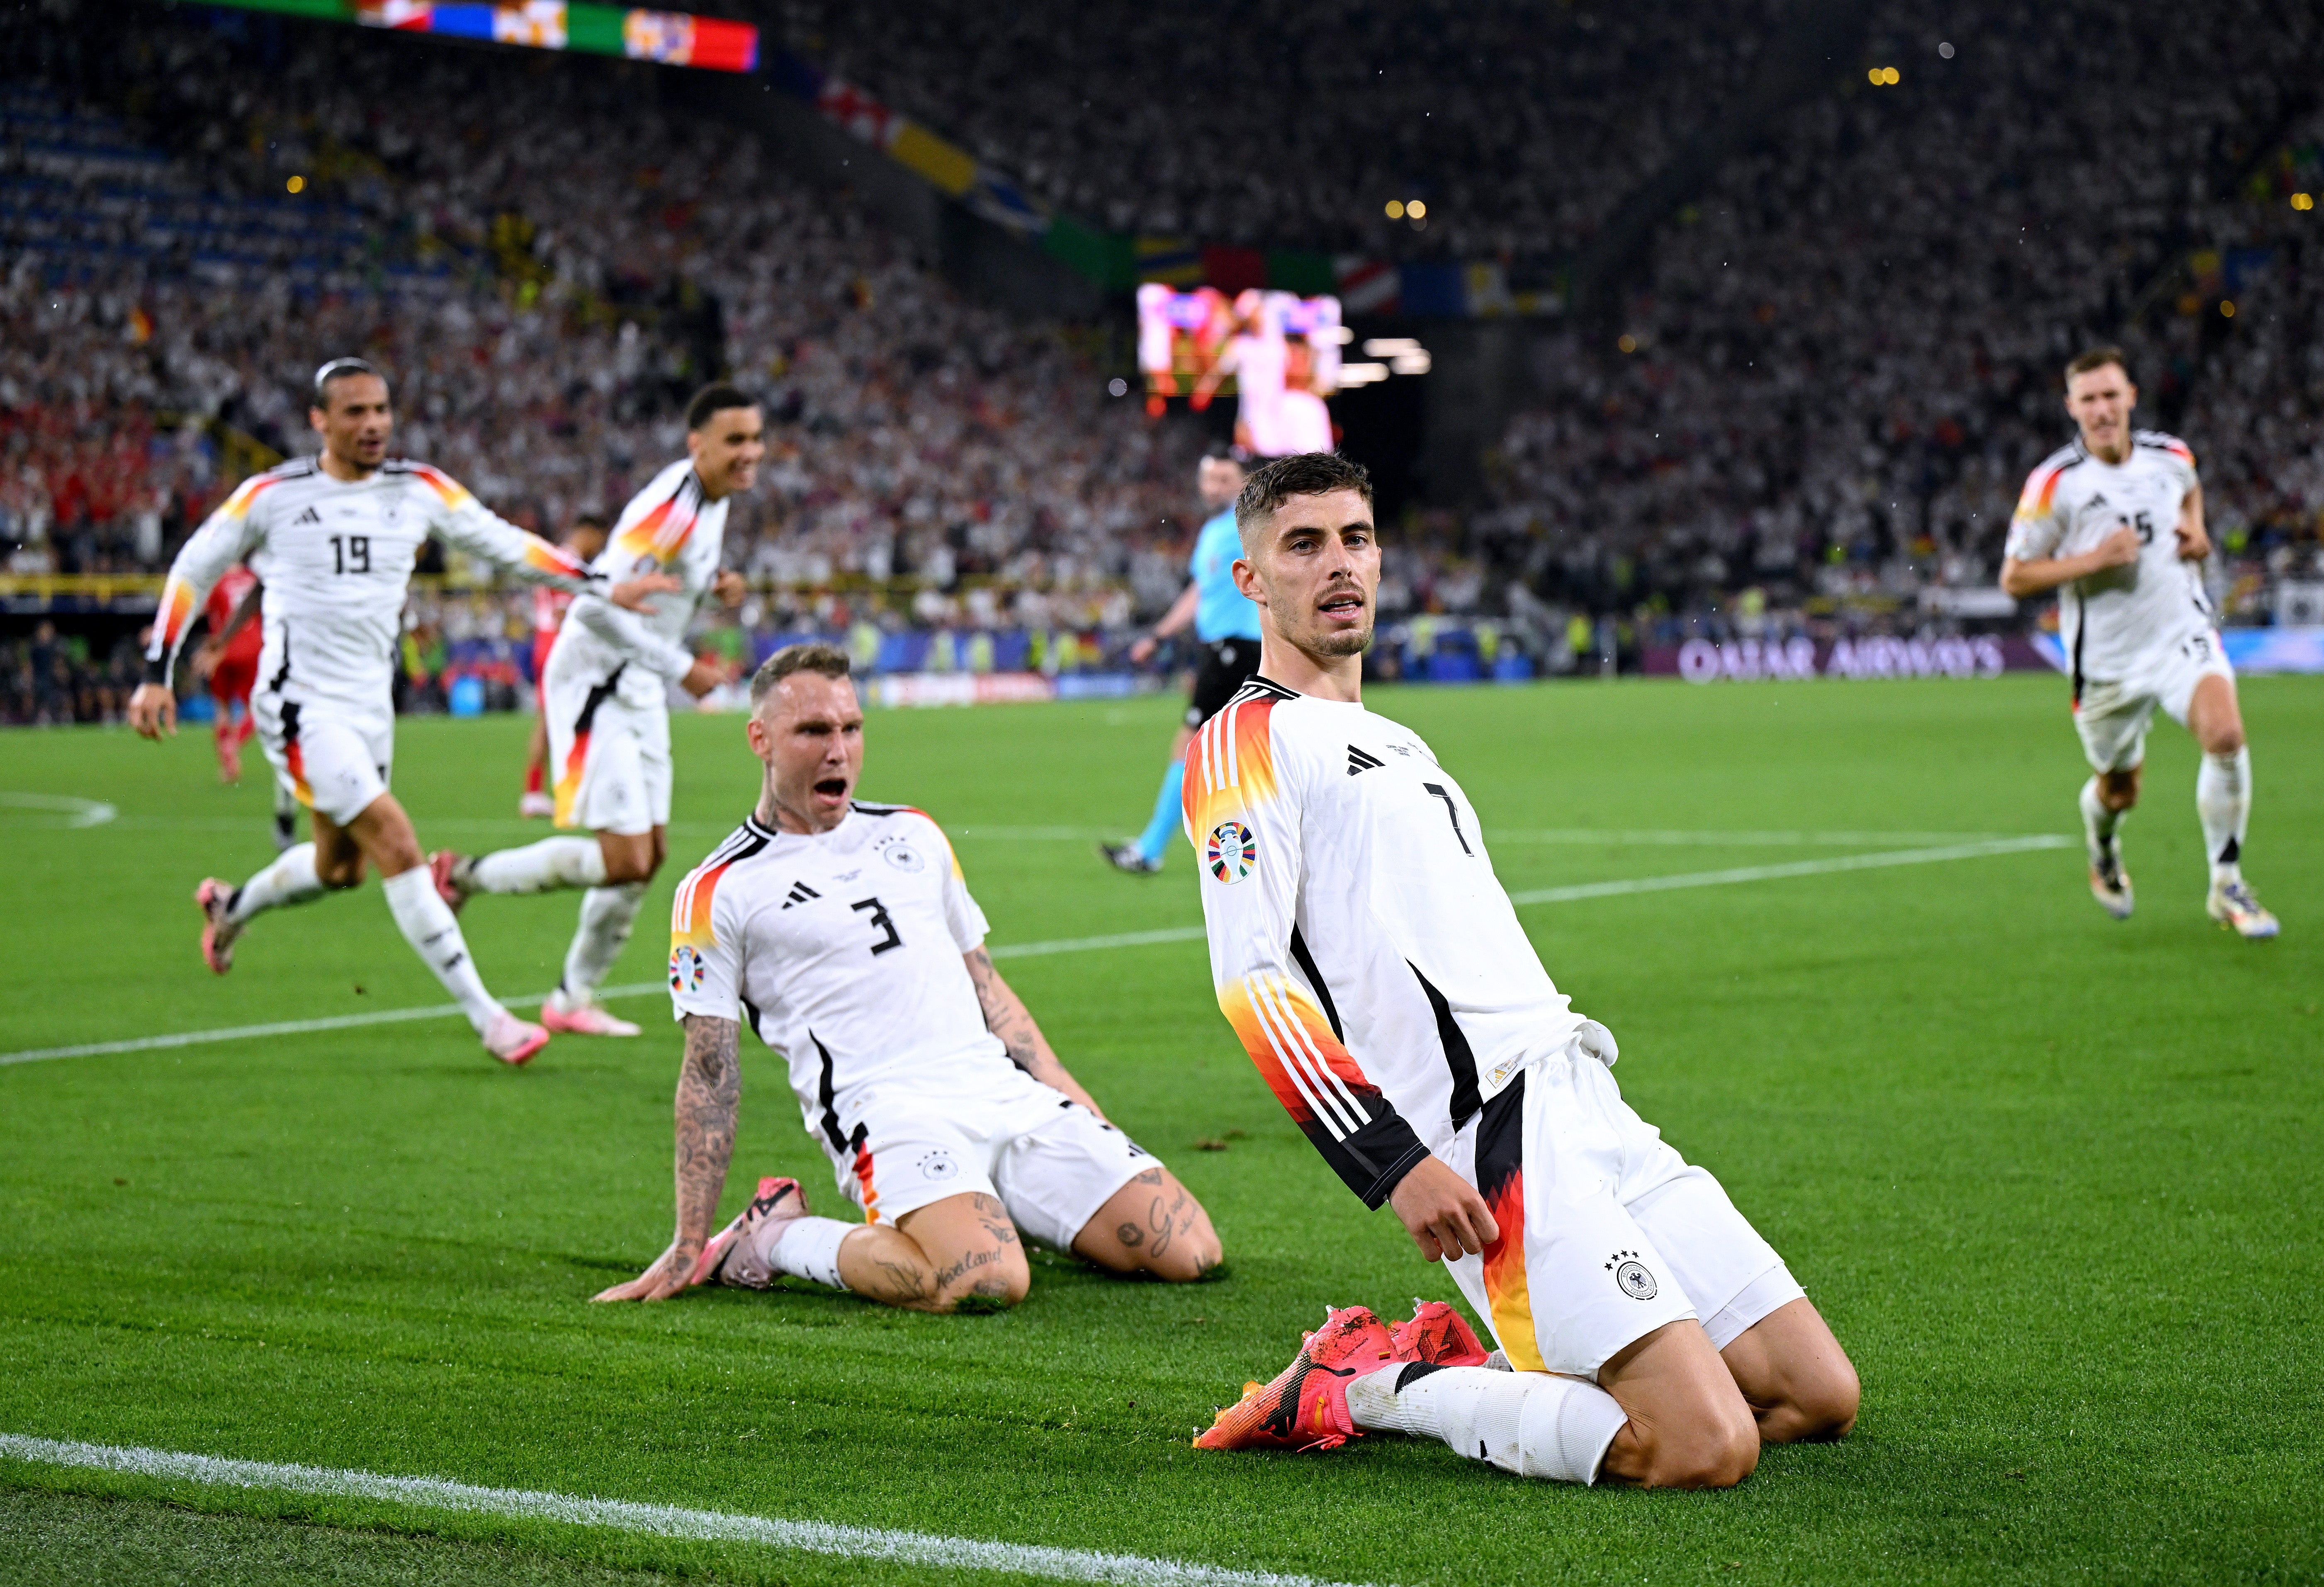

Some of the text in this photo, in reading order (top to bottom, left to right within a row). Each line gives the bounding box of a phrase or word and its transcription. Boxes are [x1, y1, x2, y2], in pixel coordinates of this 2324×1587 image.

[329, 535, 370, 574] 19
[1422, 783, 1474, 857] 7
[851, 897, 903, 956] 3
[1622, 1266, 1641, 1278] DEUTSCHER
[1355, 1337, 1369, 1349] SOPHIA
